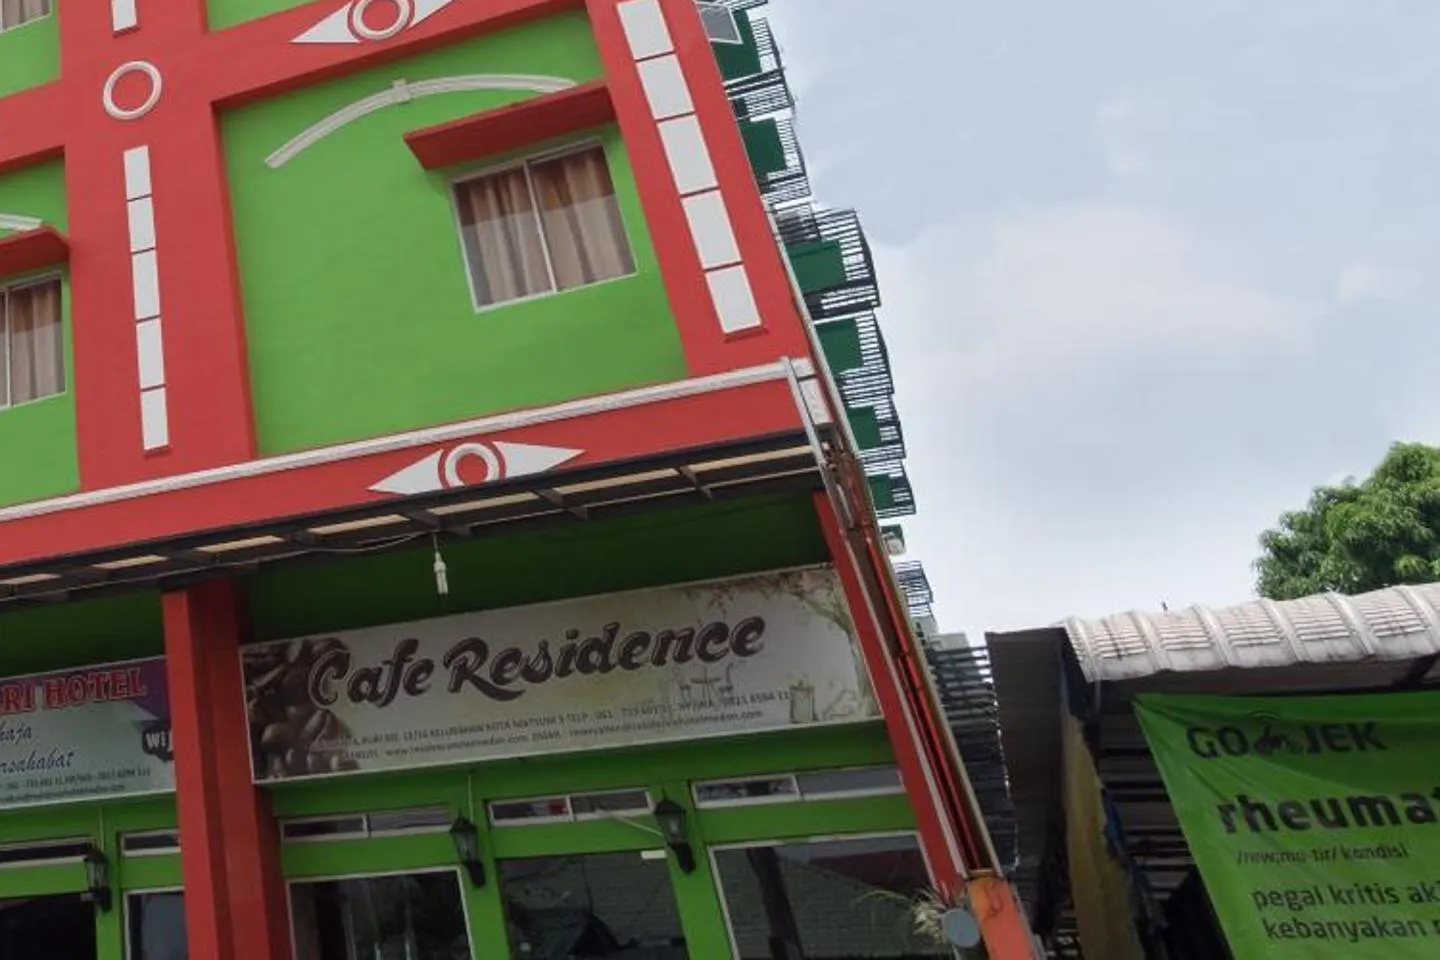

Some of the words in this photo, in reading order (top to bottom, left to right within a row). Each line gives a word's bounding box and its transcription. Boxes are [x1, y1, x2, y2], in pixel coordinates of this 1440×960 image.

[307, 636, 434, 708] Cafe
[444, 615, 767, 702] Residence
[42, 667, 148, 711] HOTEL
[1216, 785, 1440, 833] rheuma
[1252, 888, 1324, 912] pegal
[1328, 884, 1402, 907] kritis
[1408, 880, 1440, 905] ak
[1262, 916, 1427, 943] kebanyakan
